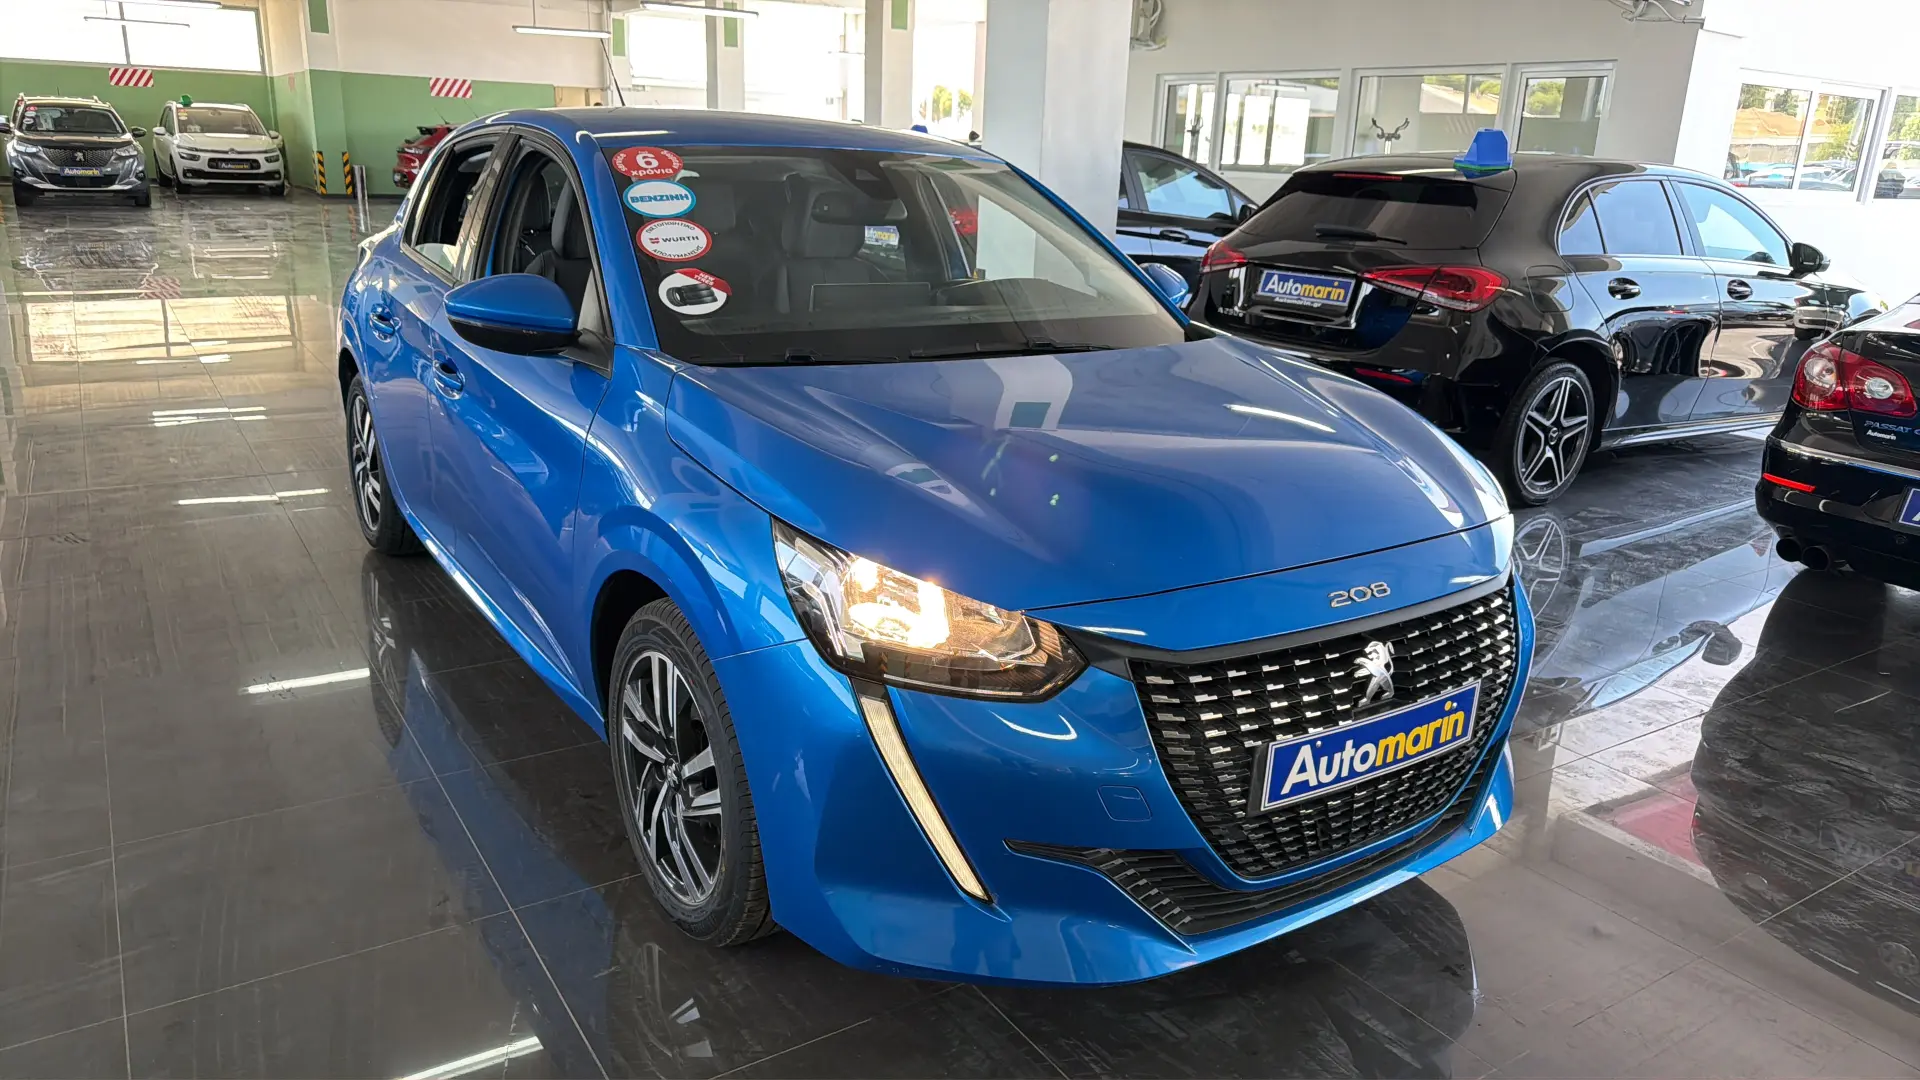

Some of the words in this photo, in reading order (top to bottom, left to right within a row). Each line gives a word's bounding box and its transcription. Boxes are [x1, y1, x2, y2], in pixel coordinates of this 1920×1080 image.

[635, 153, 659, 169] 6
[631, 168, 674, 177] χρόνια
[1265, 274, 1345, 301] Automarin
[1864, 420, 1912, 433] PASSAT
[1866, 429, 1896, 440] Automarin
[1328, 581, 1391, 608] 208
[1280, 701, 1465, 795] Automarin
